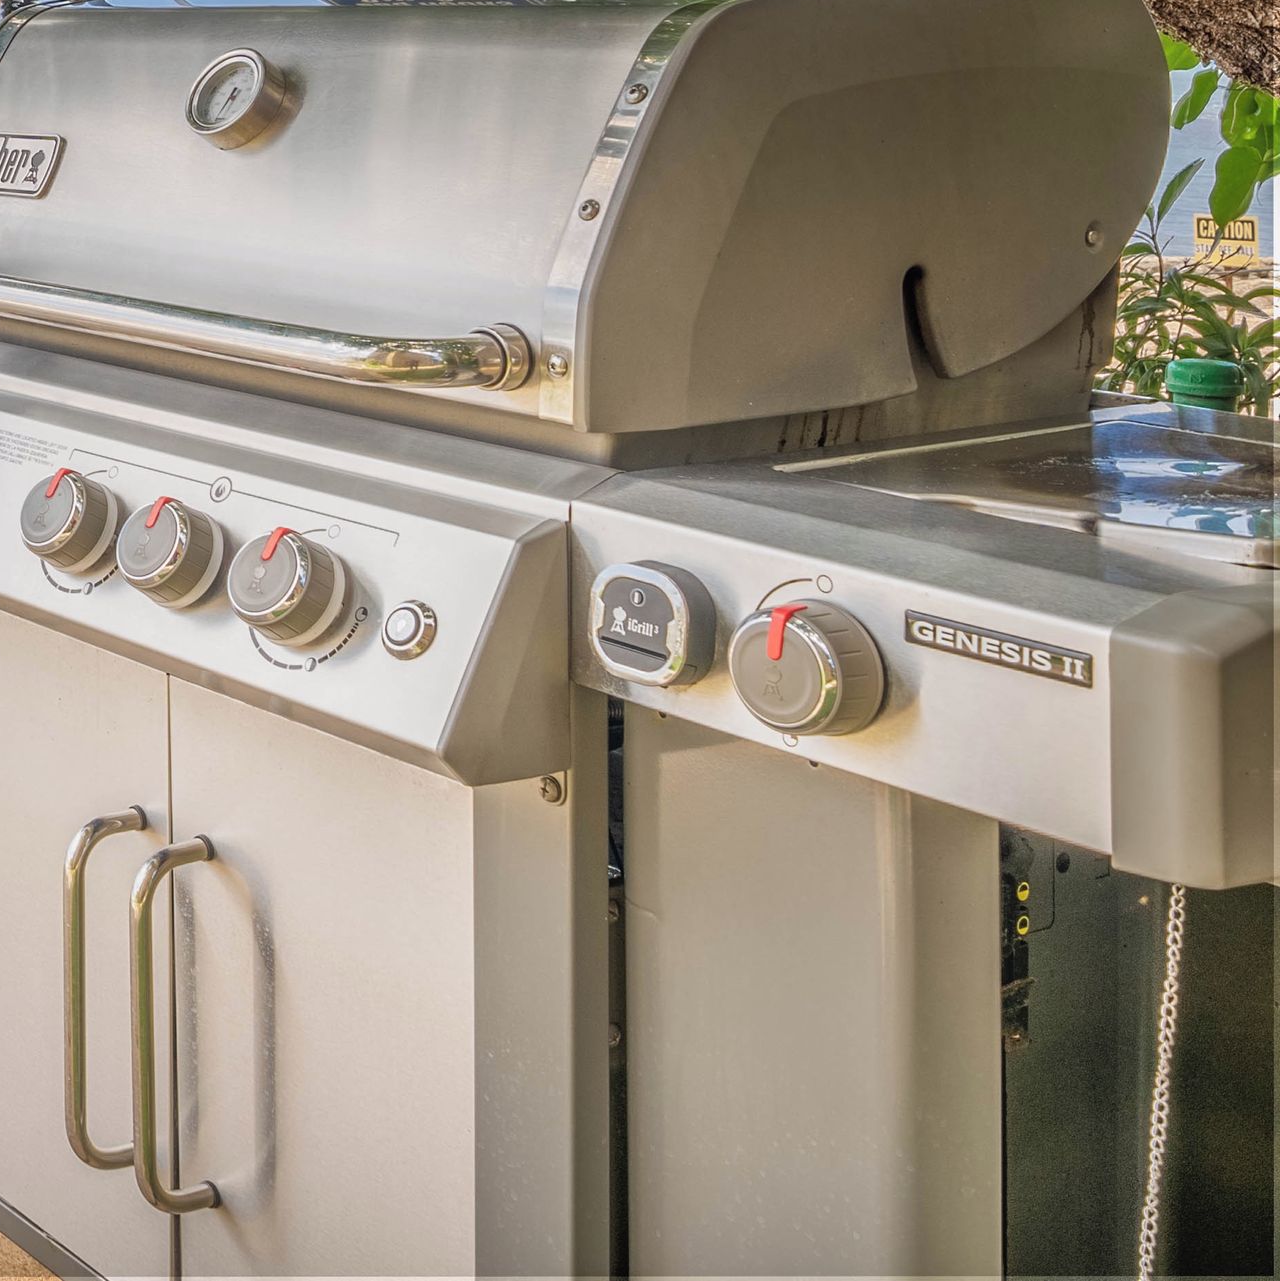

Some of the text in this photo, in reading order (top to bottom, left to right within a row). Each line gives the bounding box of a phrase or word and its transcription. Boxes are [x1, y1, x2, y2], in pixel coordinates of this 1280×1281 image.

[1199, 219, 1253, 240] CATION
[912, 620, 1085, 681] GENESIS II
